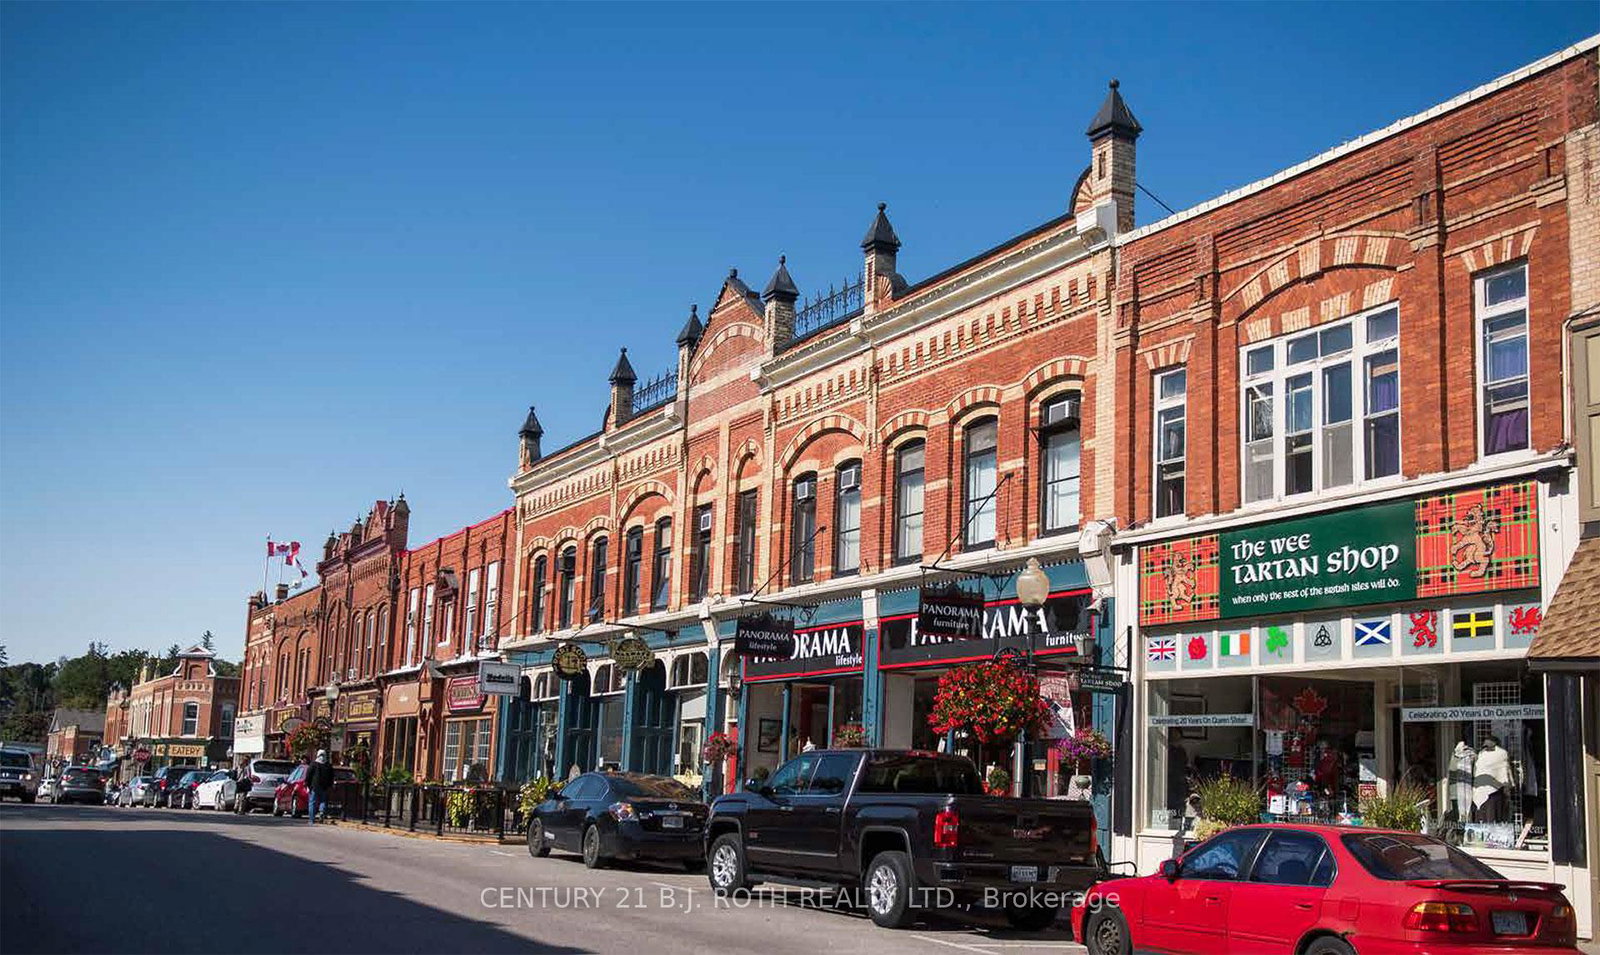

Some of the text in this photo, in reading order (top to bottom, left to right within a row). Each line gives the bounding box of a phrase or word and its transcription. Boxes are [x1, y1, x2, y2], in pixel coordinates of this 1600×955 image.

[1230, 555, 1319, 585] TARTAN
[1252, 593, 1269, 603] only
[1269, 591, 1281, 601] the
[1299, 587, 1310, 598] of
[1309, 586, 1323, 596] the
[1370, 579, 1386, 589] will
[923, 604, 980, 619] PANORAMA
[911, 605, 1049, 646] PRAMA
[933, 618, 970, 631] furniture
[739, 631, 790, 641] PANORAMA
[749, 642, 778, 651] lifestyle
[754, 627, 852, 664] RAMA
[835, 653, 863, 668] lifestyle
[1408, 709, 1448, 719] Celebrating
[1448, 709, 1459, 719] 20
[1460, 709, 1481, 718] Years
[1483, 708, 1494, 717] On
[1495, 708, 1521, 718] Queen
[172, 746, 201, 756] EATERY
